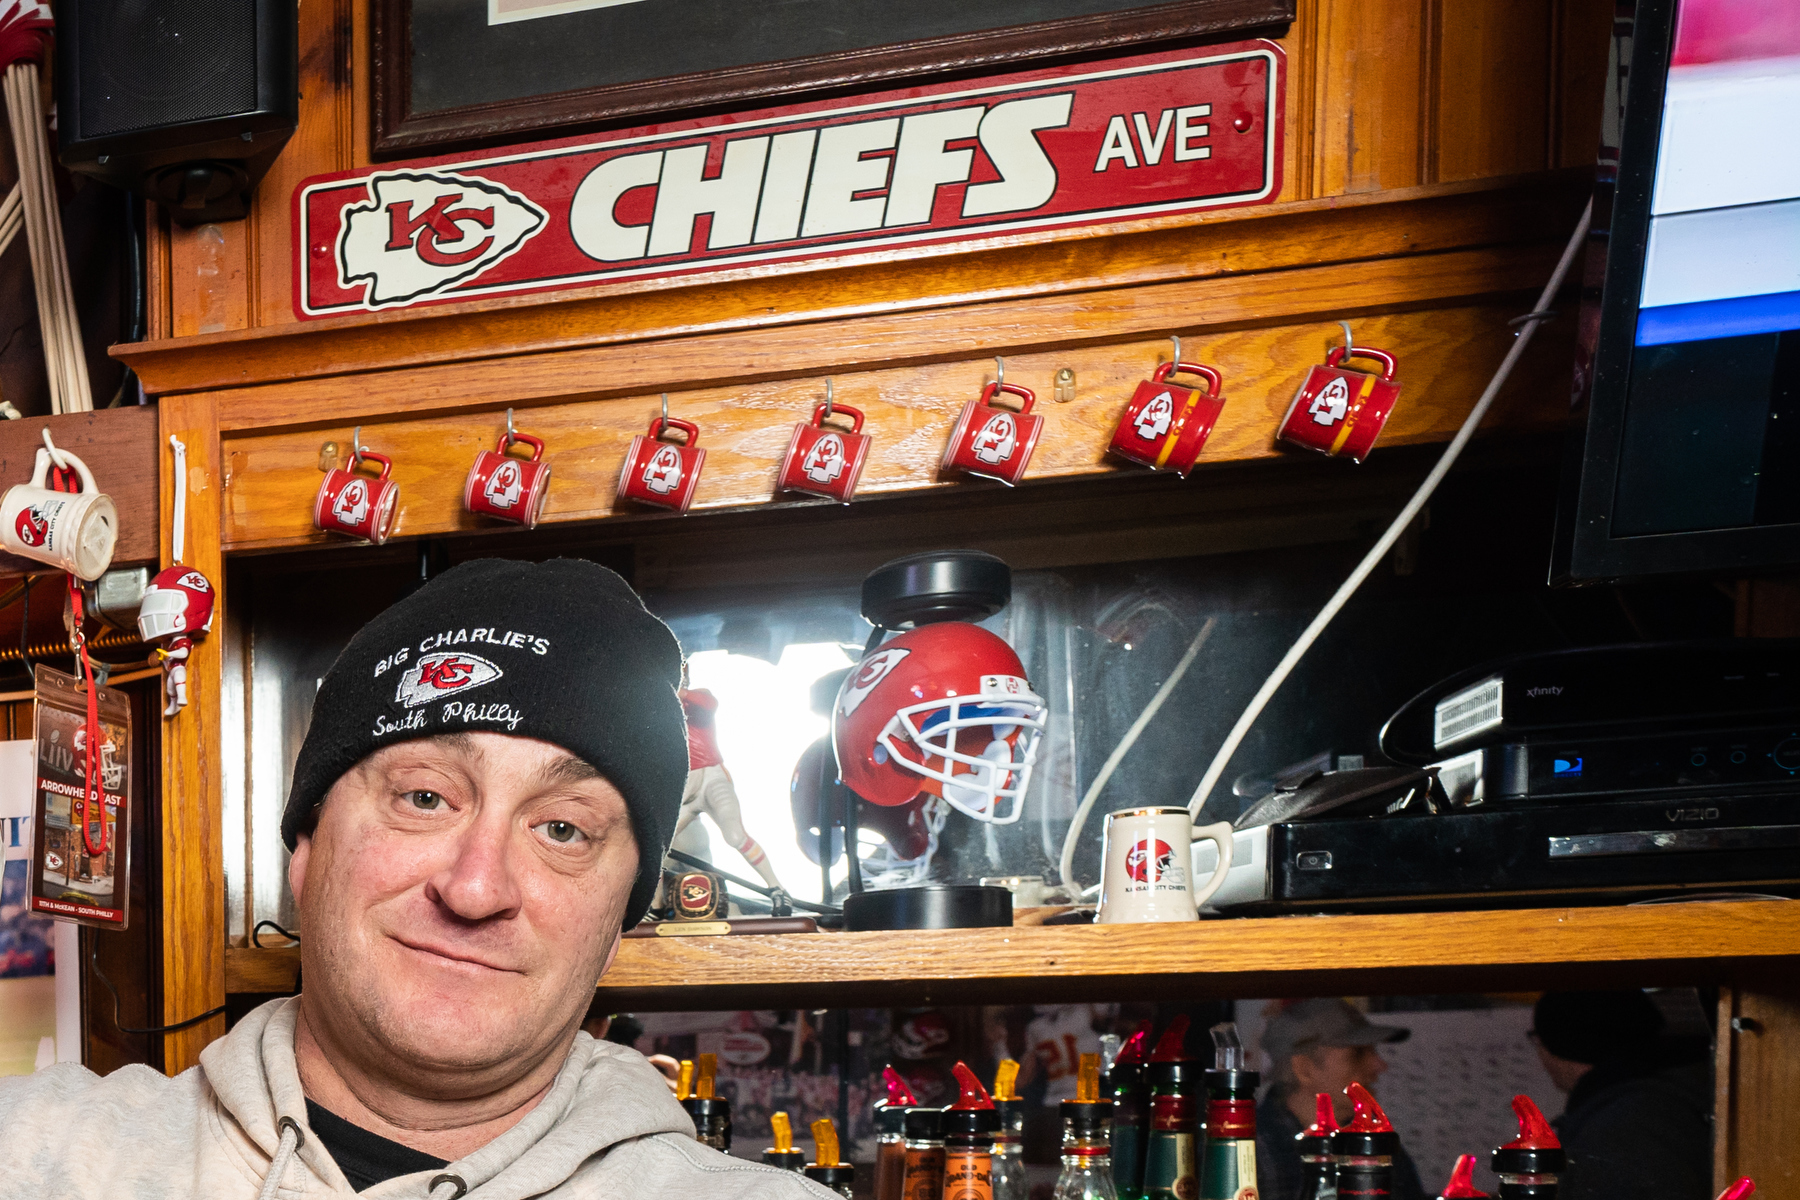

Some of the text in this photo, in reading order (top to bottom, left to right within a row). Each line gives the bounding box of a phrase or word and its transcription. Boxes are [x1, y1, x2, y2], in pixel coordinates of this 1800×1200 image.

[570, 92, 1073, 261] CHIEFS
[1094, 103, 1211, 175] AVE
[374, 627, 551, 678] BIG CHARLIE'S
[1526, 686, 1564, 698] xfinity
[372, 700, 524, 738] South Philly
[40, 779, 99, 801] ARROWHED
[1665, 807, 1719, 822] VIZIO
[78, 906, 95, 916] SOUTH
[95, 908, 114, 918] PHILLY
